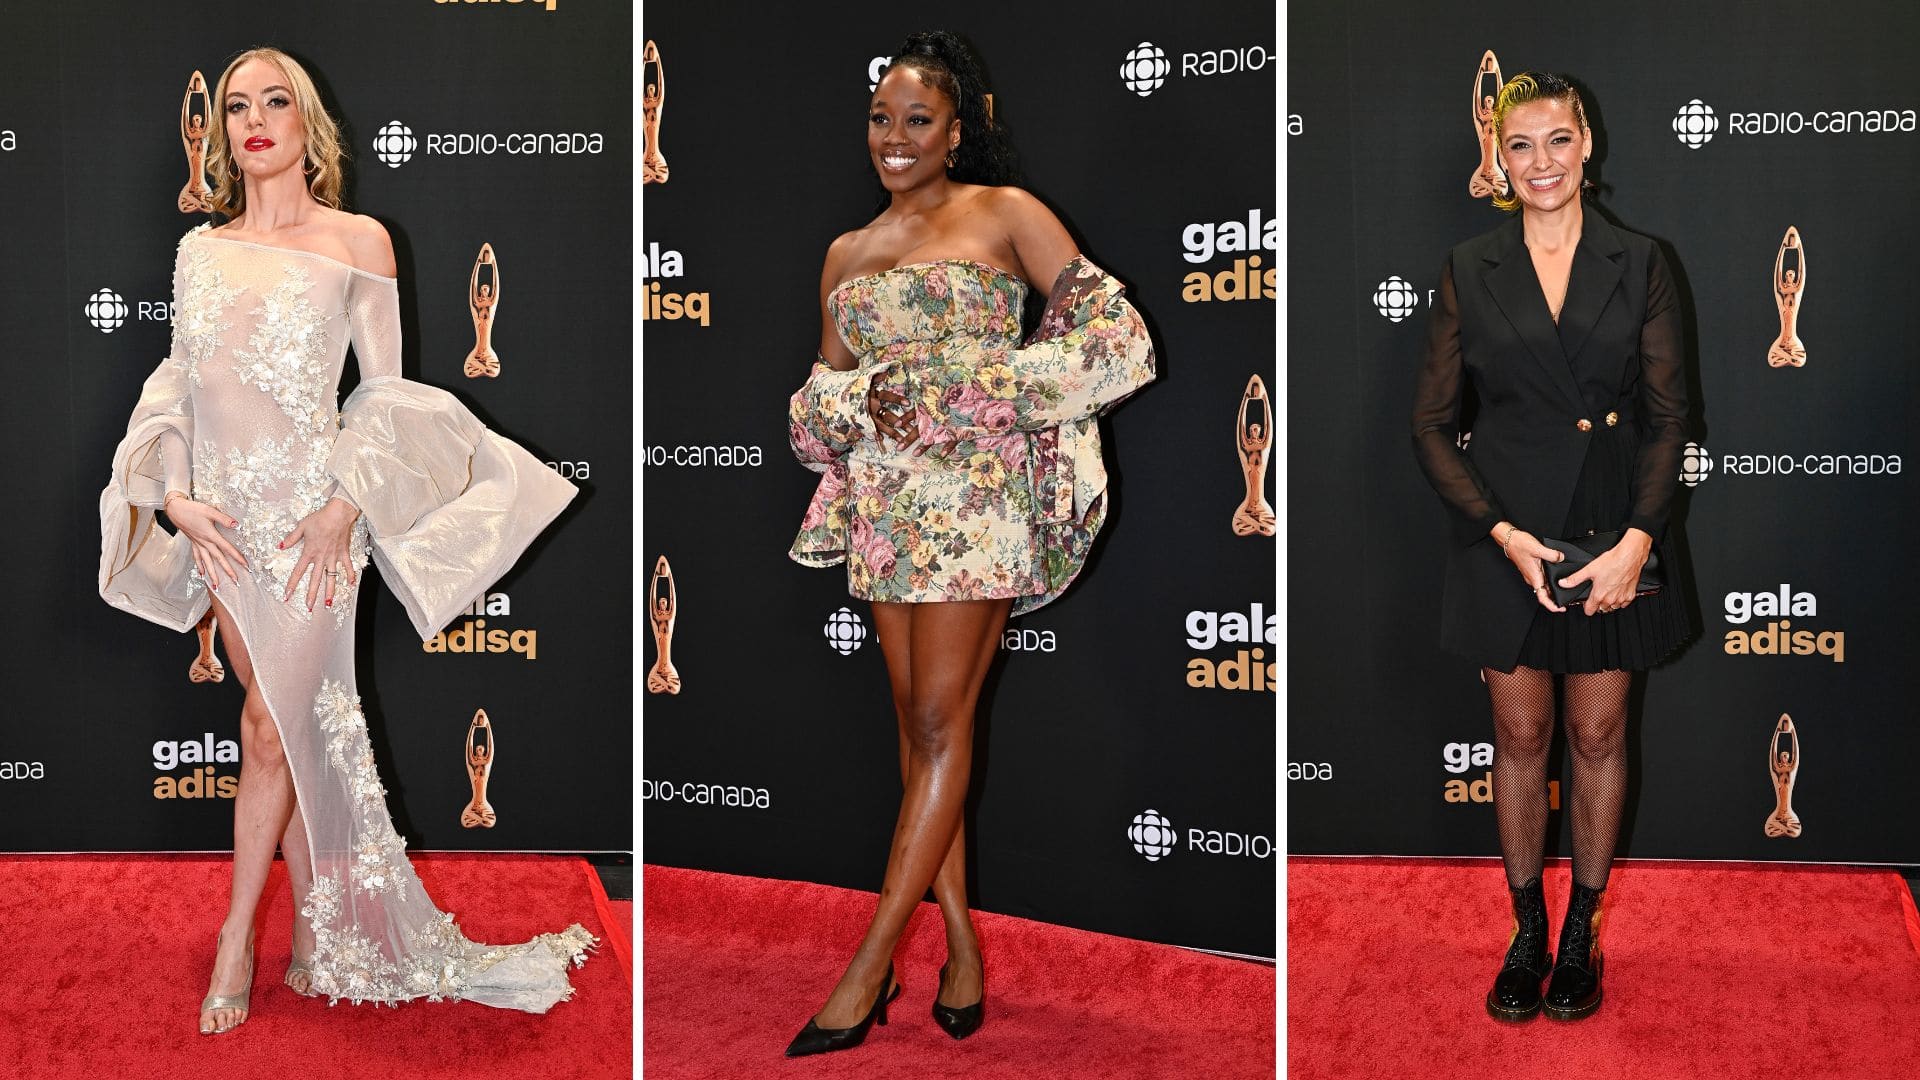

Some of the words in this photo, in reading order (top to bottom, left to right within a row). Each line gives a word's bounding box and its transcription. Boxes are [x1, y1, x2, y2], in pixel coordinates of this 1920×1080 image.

[1724, 584, 1817, 623] gala
[423, 619, 536, 660] adisq
[1724, 620, 1845, 662] adisq
[152, 733, 239, 770] gala
